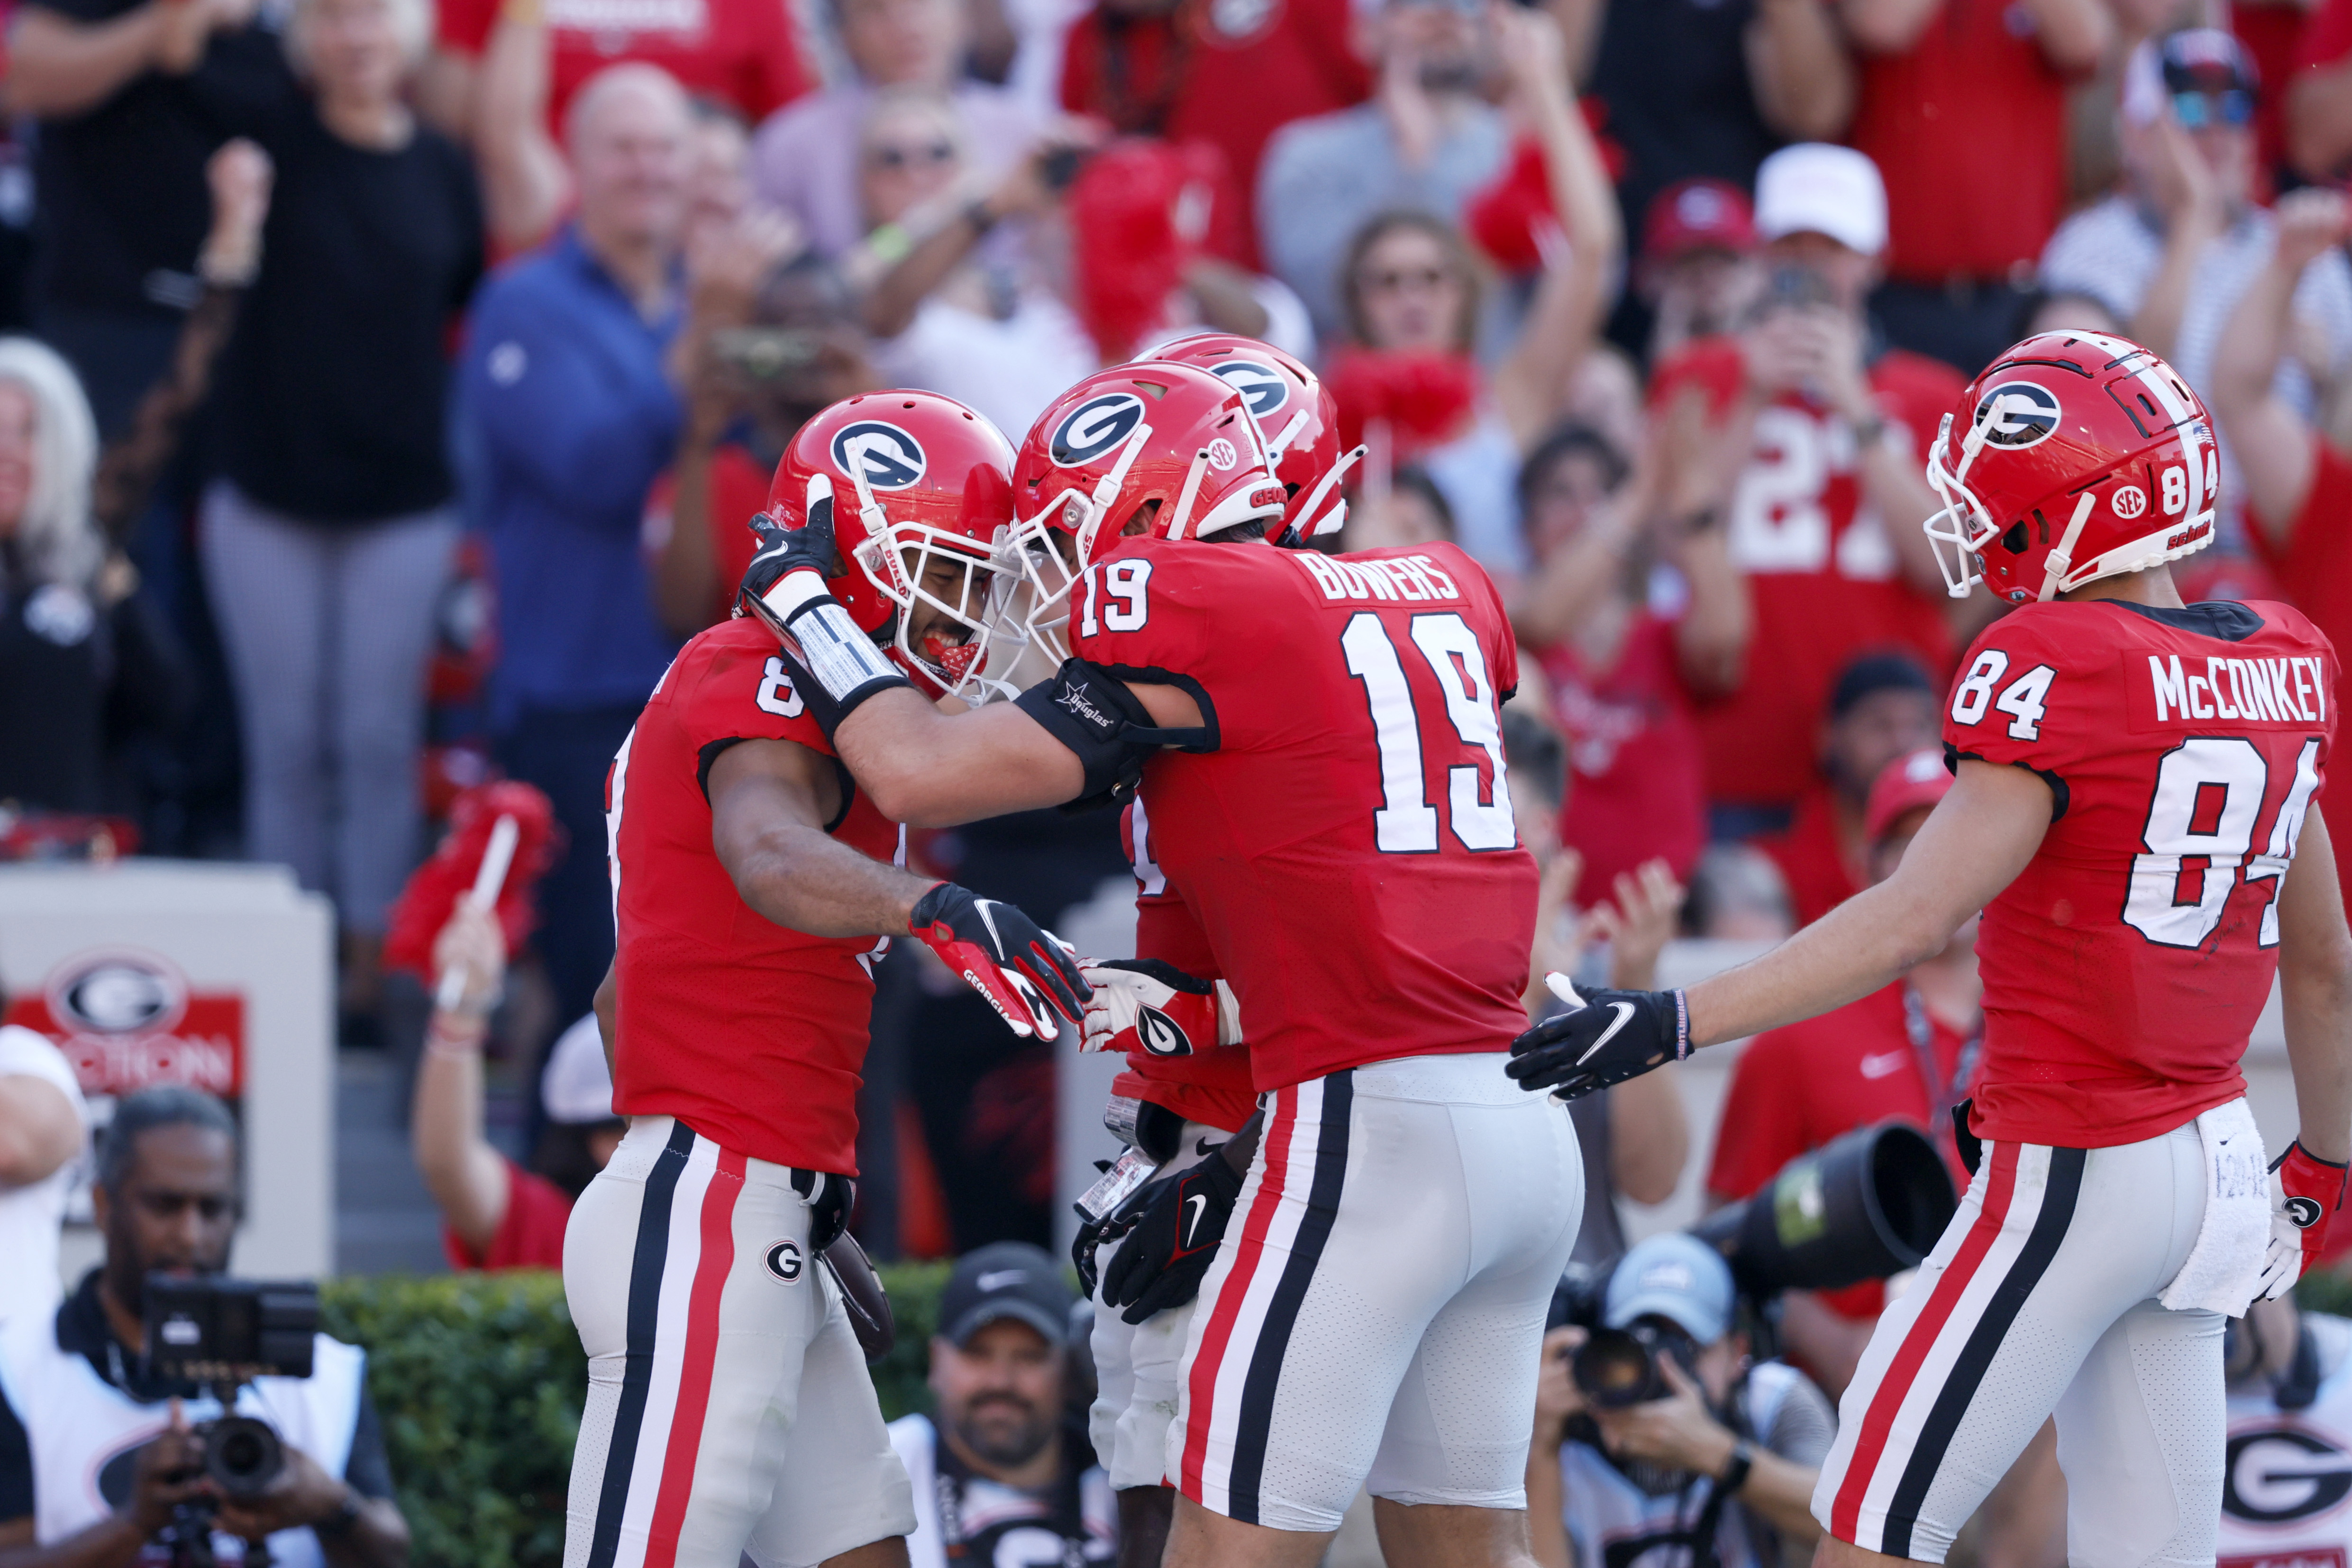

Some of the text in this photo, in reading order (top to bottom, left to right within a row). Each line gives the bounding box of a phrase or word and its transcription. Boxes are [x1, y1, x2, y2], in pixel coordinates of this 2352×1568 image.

[1052, 395, 1141, 464] G
[1976, 384, 2057, 445] G
[1211, 442, 1234, 467] SEC
[1249, 487, 1288, 508] GEOR
[2116, 490, 2142, 515] SEC
[1081, 558, 1154, 639] 19
[1293, 553, 1459, 601] BOWERS
[1070, 693, 1110, 727] Douglas
[1951, 648, 2059, 742] 84
[2148, 655, 2325, 722] McCONKEY
[1340, 611, 1516, 853] 19
[2120, 736, 2322, 950] 84
[963, 969, 1010, 1021] GEORGIA
[766, 1243, 802, 1279] G
[2222, 1431, 2352, 1521] G
